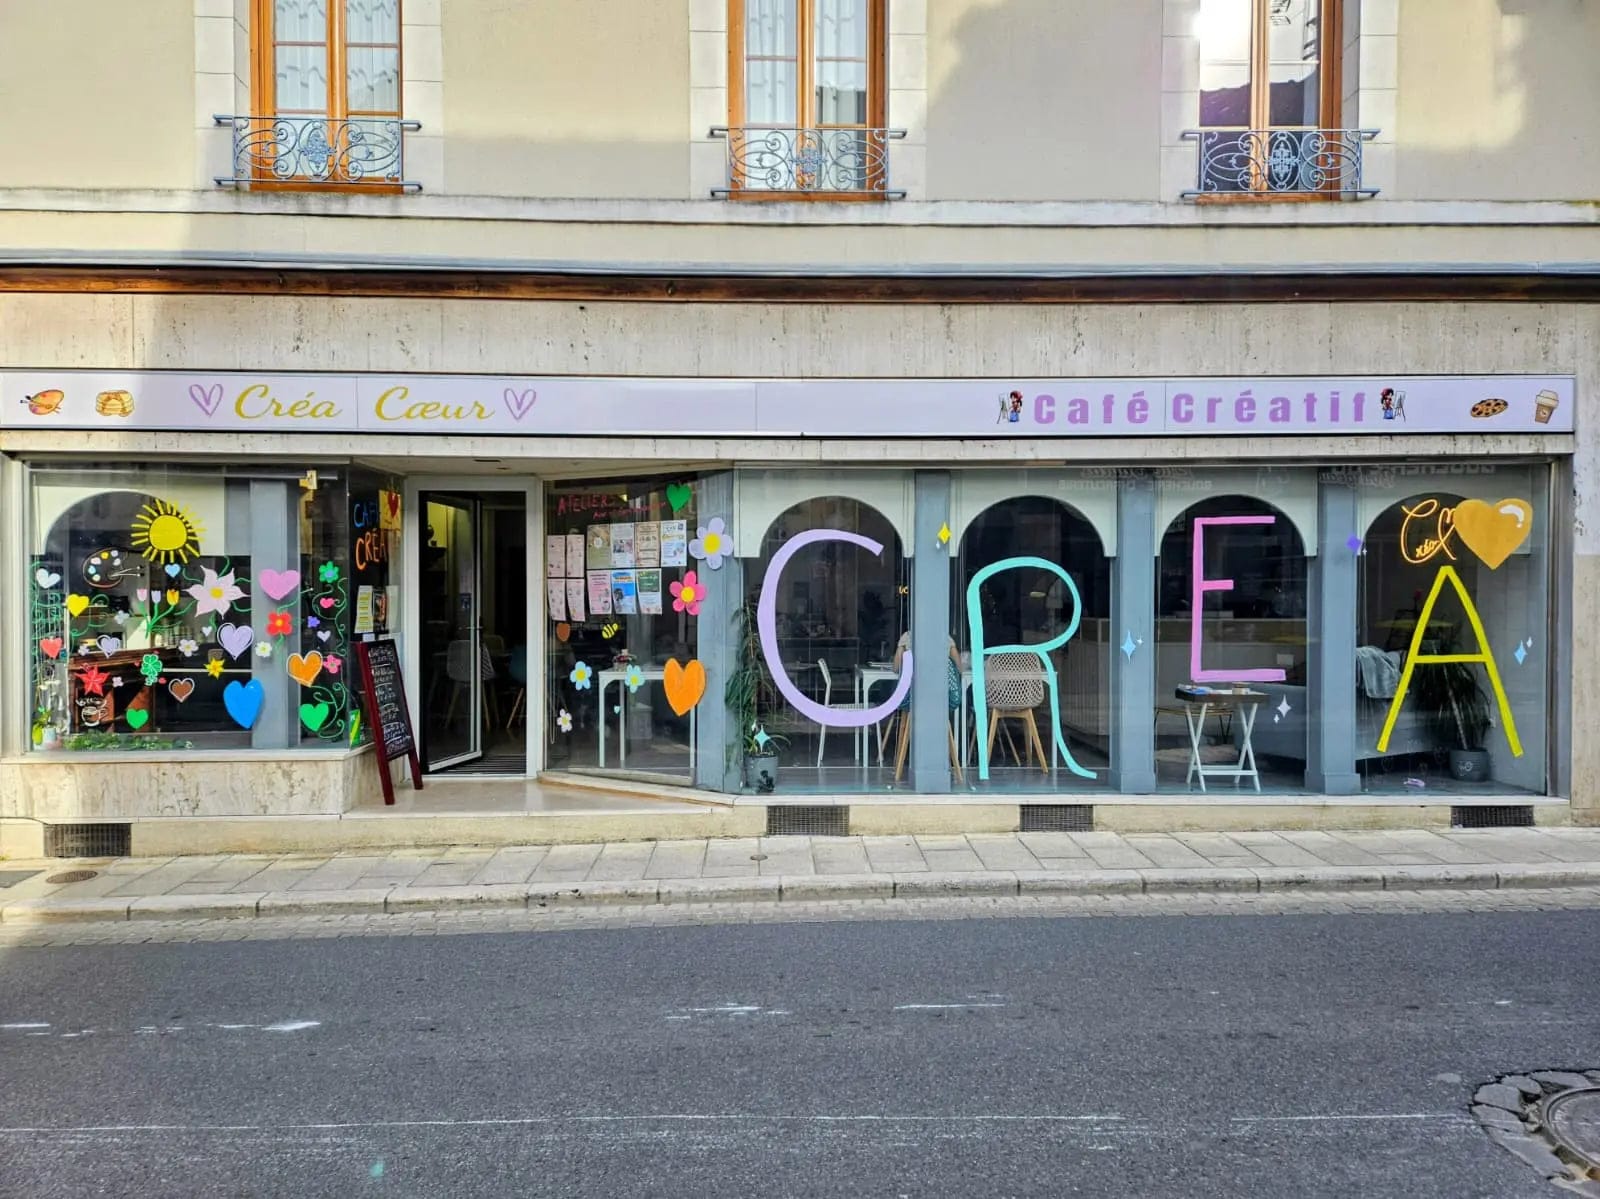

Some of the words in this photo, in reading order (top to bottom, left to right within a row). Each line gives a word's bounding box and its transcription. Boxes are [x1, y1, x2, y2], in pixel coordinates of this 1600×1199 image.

[234, 384, 342, 419] Créa
[375, 386, 495, 421] Cœur
[1033, 390, 1149, 424] Café
[1172, 389, 1366, 423] Créatif
